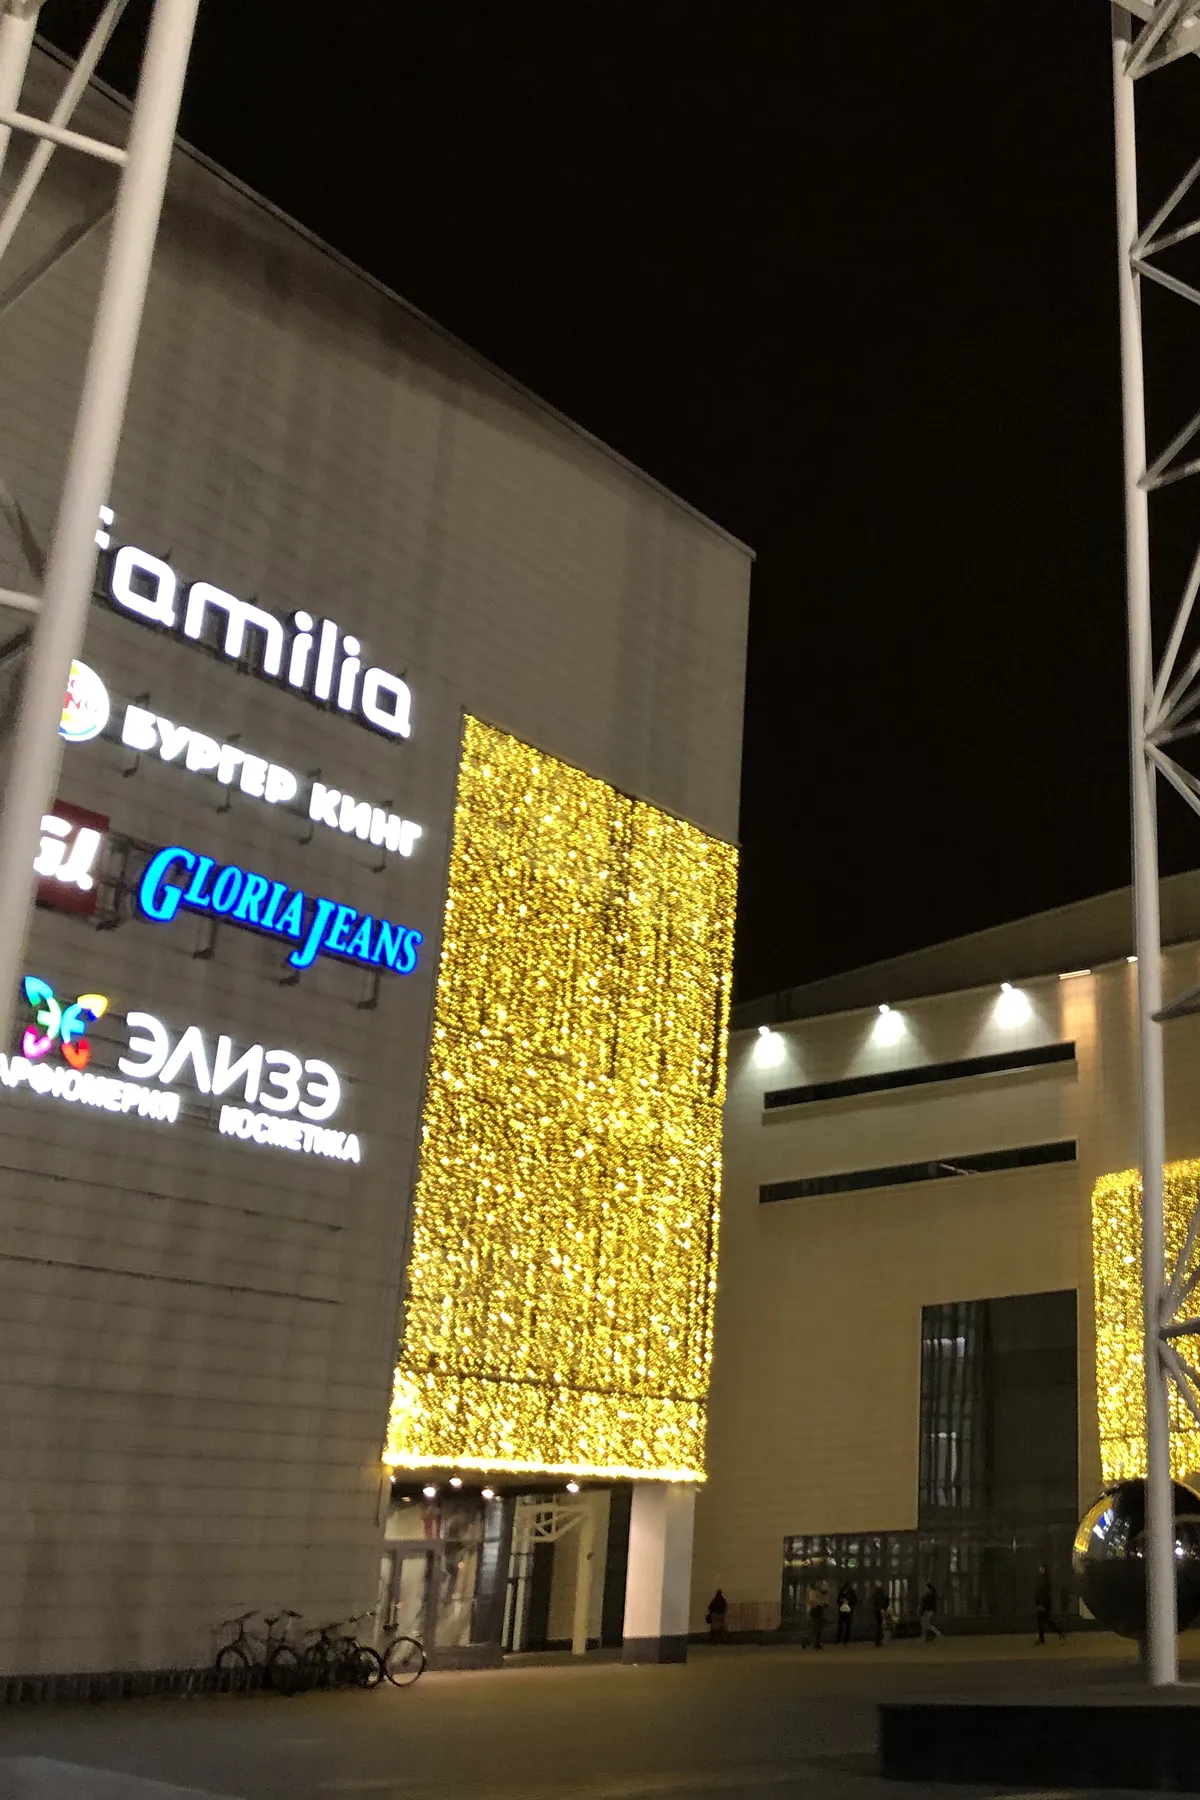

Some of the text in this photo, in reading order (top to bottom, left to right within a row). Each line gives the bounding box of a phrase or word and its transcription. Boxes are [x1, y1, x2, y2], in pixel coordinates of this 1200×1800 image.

[121, 704, 423, 857] БУРГЕР КИНГ
[118, 1011, 341, 1122] ЭЛИЗЭ
[218, 1104, 361, 1163] КОСМЕТИКА
